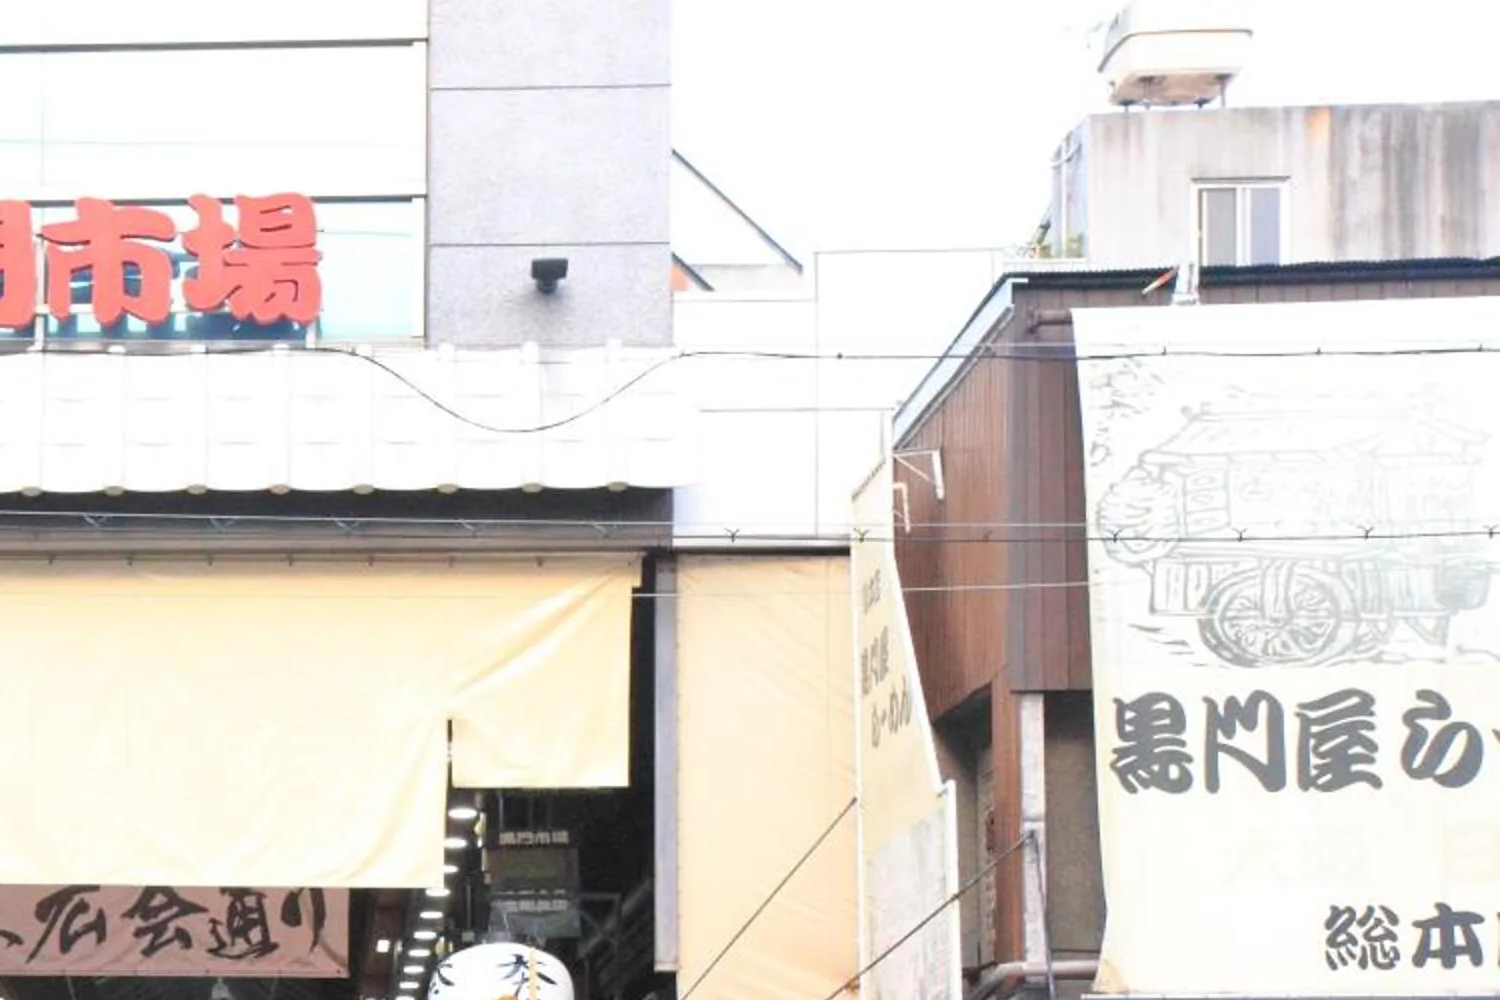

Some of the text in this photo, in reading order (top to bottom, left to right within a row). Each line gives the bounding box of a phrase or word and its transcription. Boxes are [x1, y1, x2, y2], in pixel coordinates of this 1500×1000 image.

[1110, 688, 1500, 795] 黒門屋ら
[1324, 901, 1500, 971] 総本
